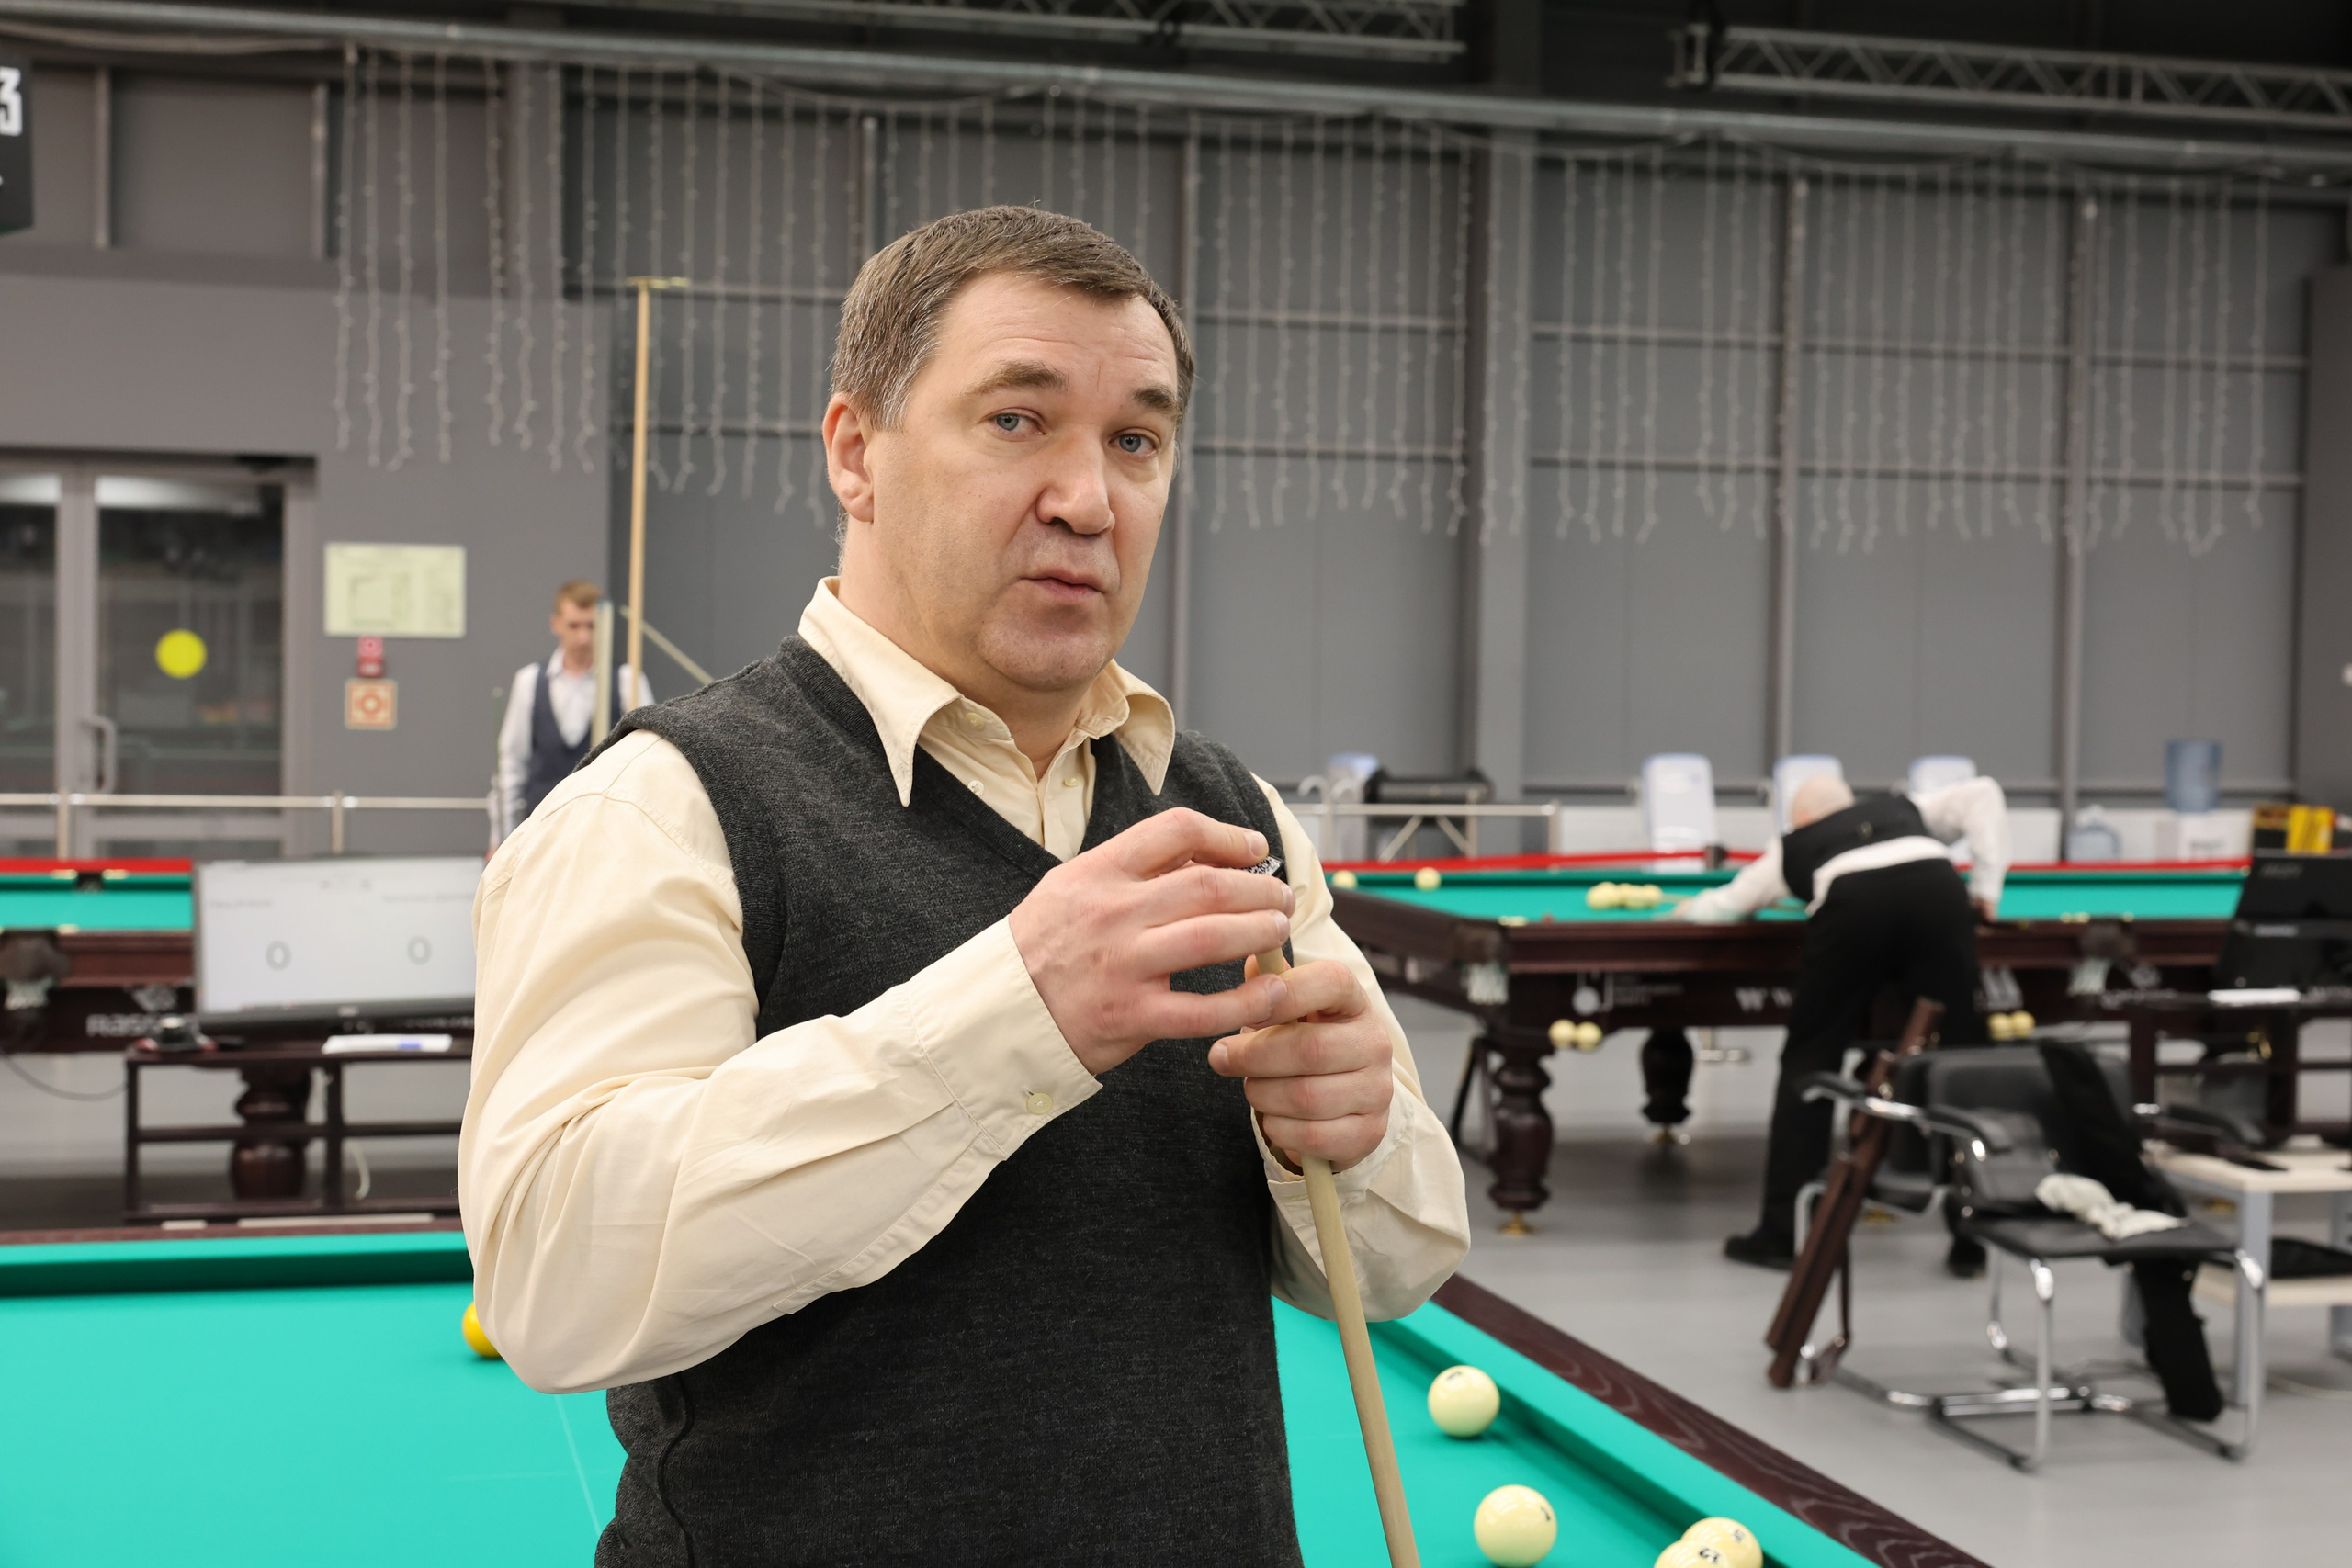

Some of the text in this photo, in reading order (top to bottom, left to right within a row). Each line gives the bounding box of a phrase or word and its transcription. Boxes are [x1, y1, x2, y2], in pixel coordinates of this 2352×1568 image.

[0, 65, 23, 137] 3
[266, 941, 291, 971] 0
[407, 935, 432, 965] 0
